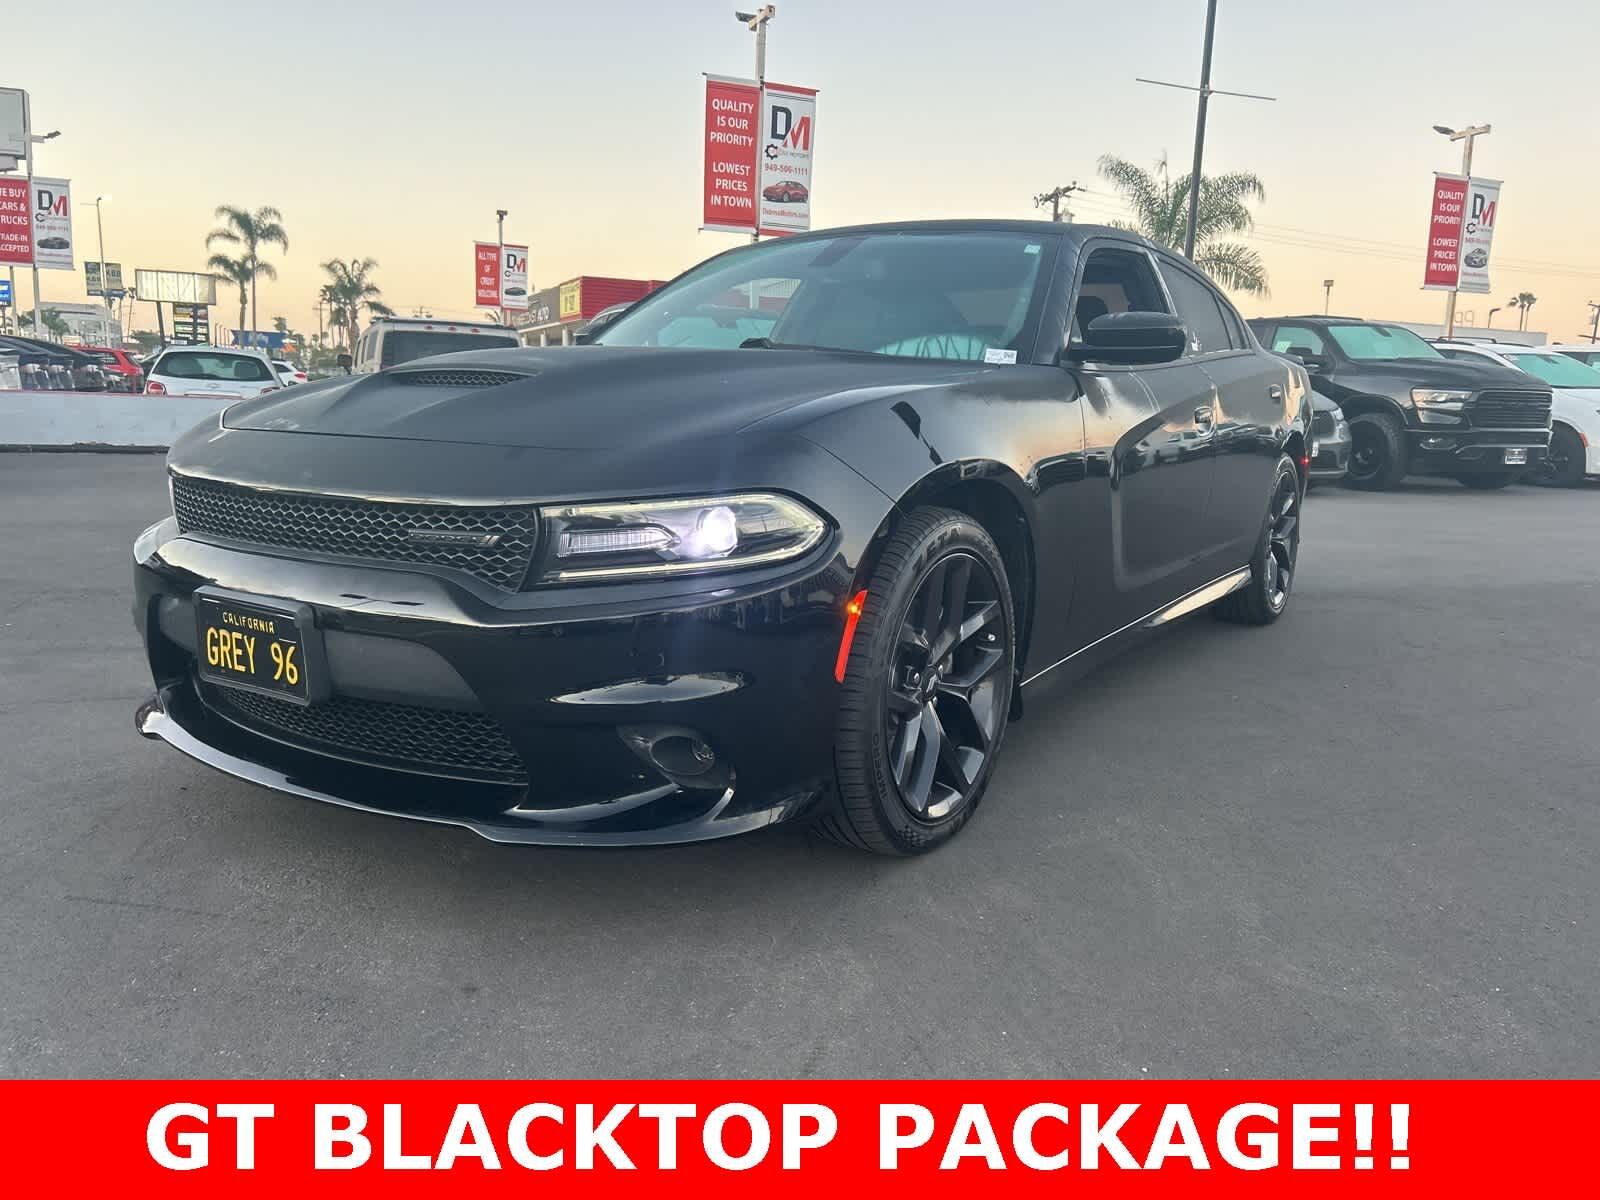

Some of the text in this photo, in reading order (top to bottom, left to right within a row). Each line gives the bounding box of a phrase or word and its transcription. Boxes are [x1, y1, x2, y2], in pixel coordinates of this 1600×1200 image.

[712, 99, 753, 114] QUALITY
[717, 116, 748, 130] IS OUR
[771, 105, 811, 151] DM
[710, 132, 754, 147] PRIORITY
[712, 162, 751, 176] LOWEST
[716, 178, 748, 192] PRICES
[0, 188, 26, 198] E BUY
[1438, 190, 1464, 201] QUALITY
[710, 195, 752, 208] IN TOWN
[20, 204, 26, 212] &
[1440, 203, 1460, 213] IS OUR
[0, 216, 28, 226] RUCKS
[1433, 237, 1458, 247] LOWEST
[0, 244, 29, 253] CCEPTED
[1434, 250, 1456, 260] PRICES
[1430, 263, 1457, 272] IN TOWN
[222, 612, 275, 634] CALIFORNIA
[206, 626, 298, 685] GREY 96
